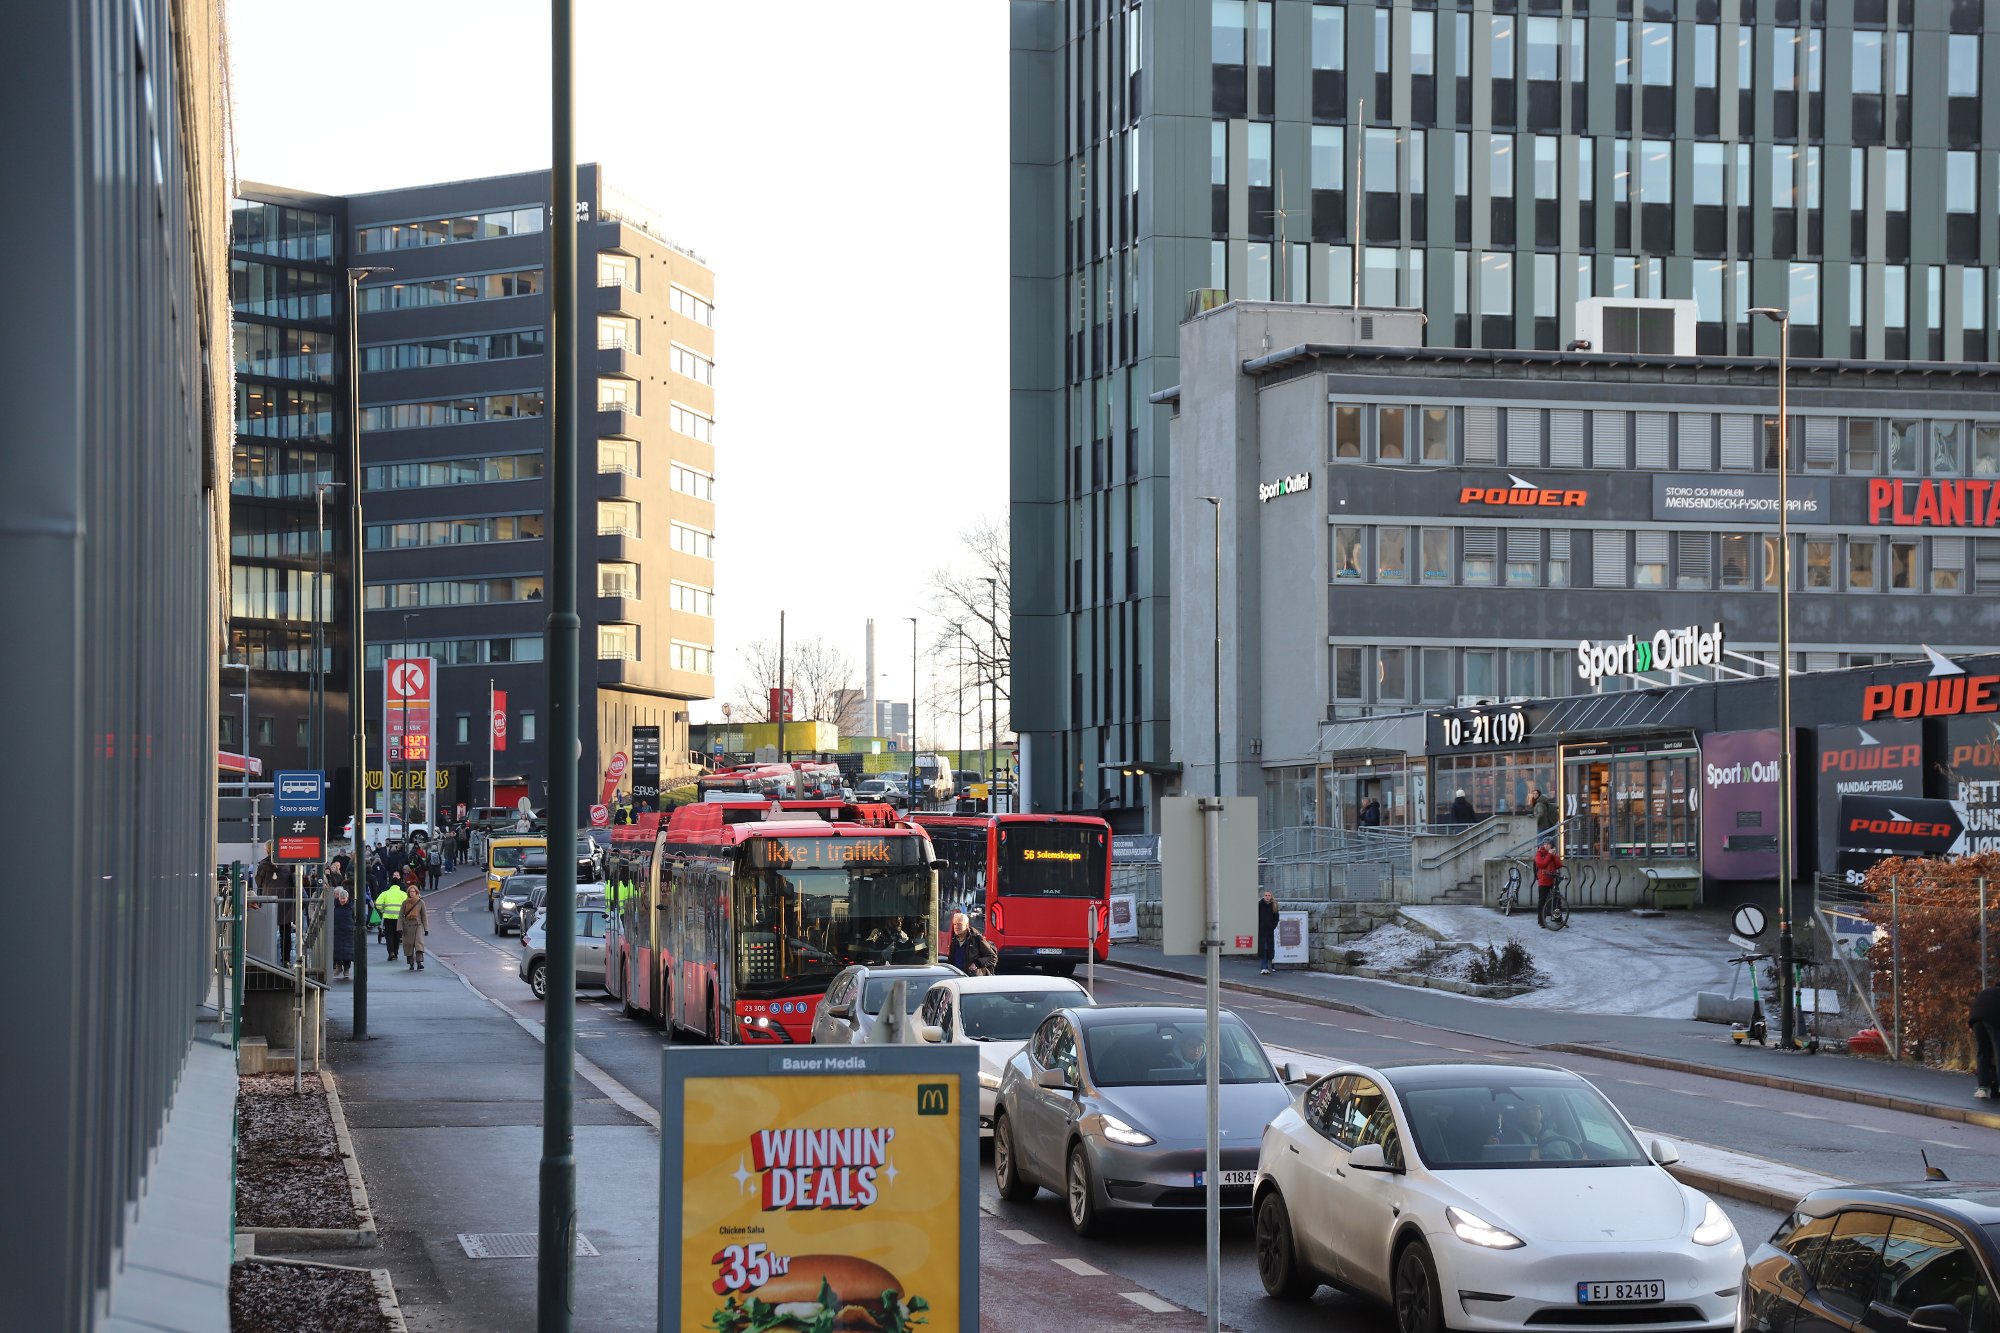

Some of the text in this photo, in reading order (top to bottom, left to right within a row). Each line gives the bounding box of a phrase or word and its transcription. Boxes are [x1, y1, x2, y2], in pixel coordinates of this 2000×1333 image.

[1259, 471, 1310, 503] Sport Outlet
[1459, 487, 1588, 506] POWER
[1665, 487, 1745, 497] STORO OG NYDALEN
[1665, 497, 1818, 511] MENSENDIECK-FYSIOTEAPI AS
[1578, 622, 1723, 686] Sport Outlet
[1862, 675, 2000, 721] POWE
[1443, 718, 1461, 746] 10
[1473, 715, 1490, 744] 21
[1820, 744, 1921, 773] POWER
[1707, 761, 1781, 789] Sport Outl
[1837, 779, 1904, 793] MANDAG-FREDAG
[1958, 780, 2000, 803] RETT
[1849, 818, 1952, 837] POWER
[767, 841, 808, 862] Ikke
[827, 840, 891, 863] trafikk
[1024, 850, 1081, 861] 56 Solemskogen
[782, 1057, 866, 1070] Bauer Media
[753, 1128, 895, 1171] WINNIN'
[764, 1166, 878, 1210] DEALS
[720, 1226, 746, 1234] Chicken
[1593, 1286, 1609, 1299] EJ
[1616, 1283, 1658, 1298] 82419
